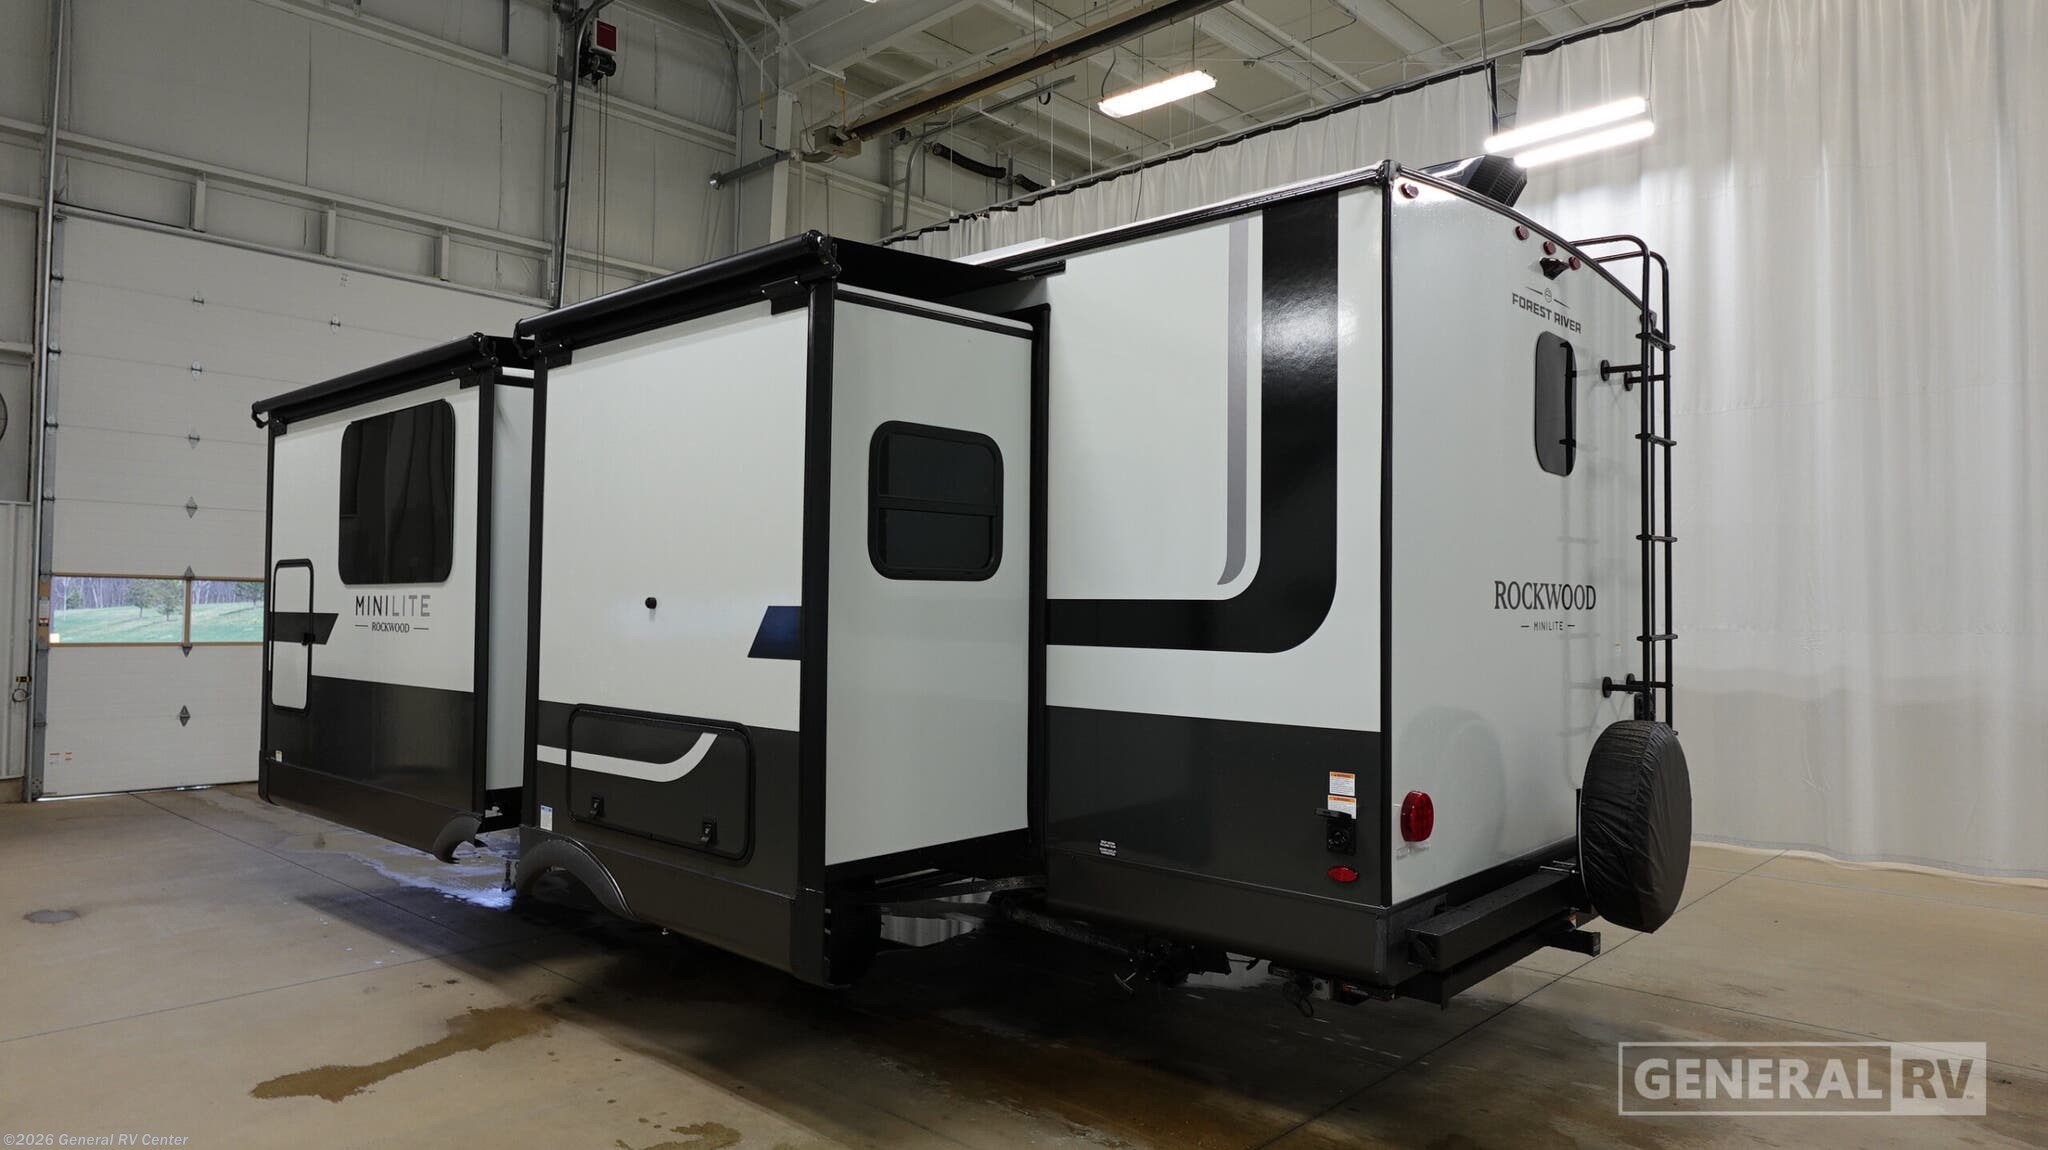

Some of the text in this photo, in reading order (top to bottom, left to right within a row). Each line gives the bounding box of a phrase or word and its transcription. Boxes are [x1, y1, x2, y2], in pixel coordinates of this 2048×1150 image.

[1512, 292, 1582, 334] FOREST RIVER
[355, 595, 431, 617] MINILITE
[1494, 580, 1596, 610] ROCKWOOD
[371, 621, 410, 633] ROCKWOOD
[1533, 621, 1564, 631] MINILITE
